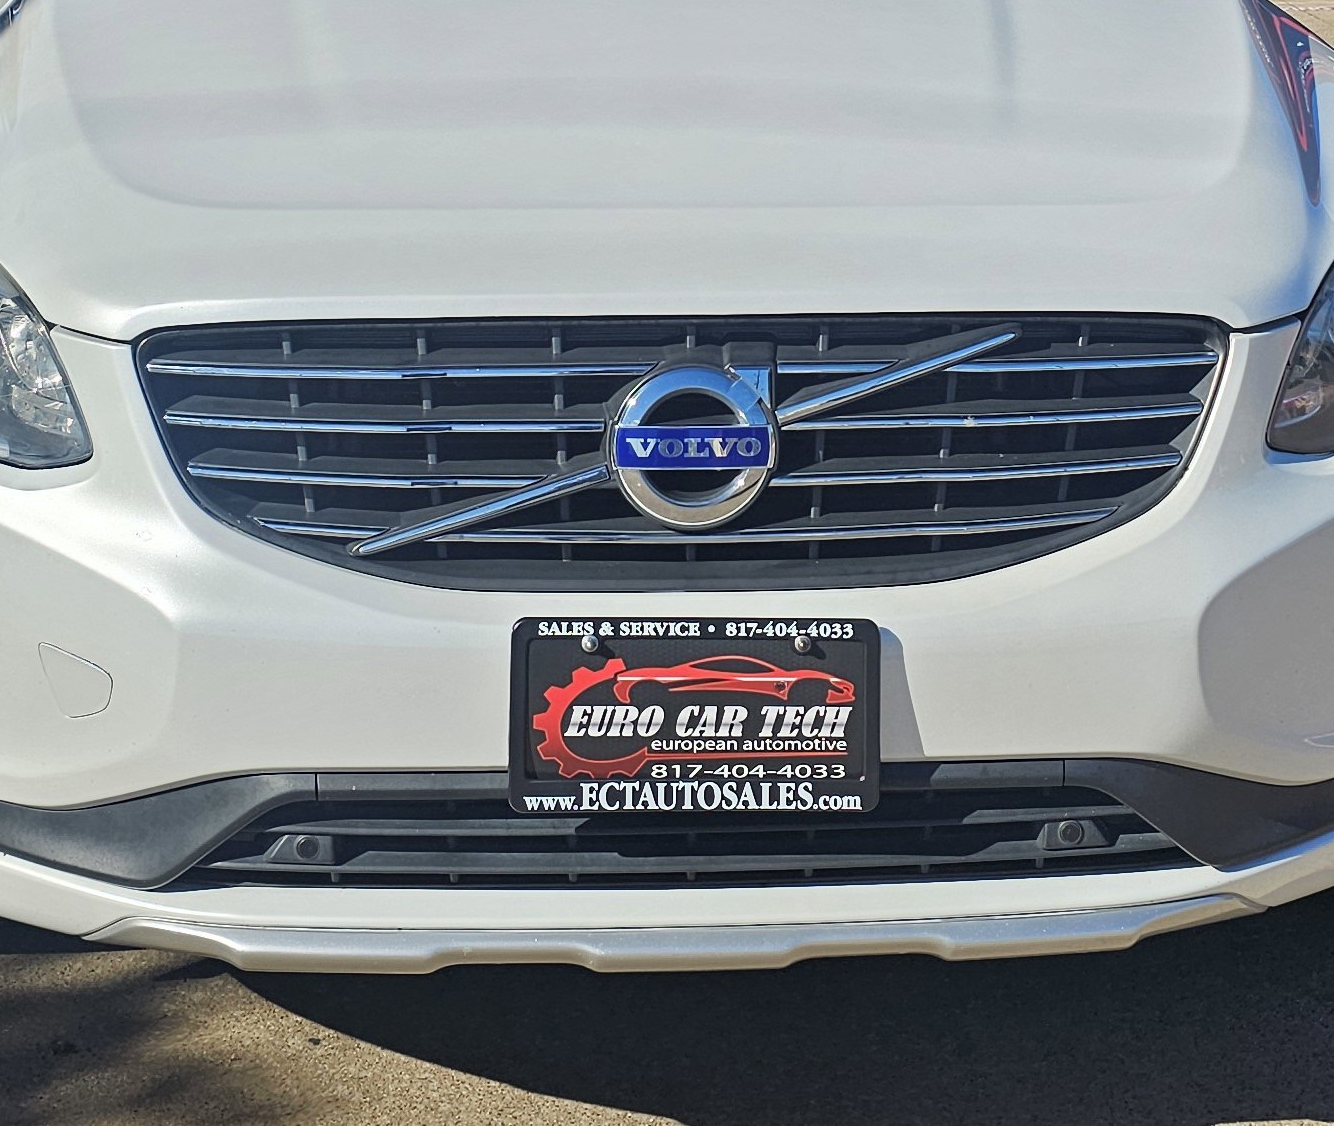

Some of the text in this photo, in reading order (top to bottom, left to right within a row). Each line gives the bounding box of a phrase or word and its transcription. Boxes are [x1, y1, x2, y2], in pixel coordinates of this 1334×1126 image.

[626, 437, 762, 458] VOLVO
[538, 621, 854, 639] SALES & SERVICE 817-404-4033
[563, 705, 853, 738] EURO CAR TECH
[650, 737, 848, 754] european automotive
[650, 763, 846, 779] 817-404-4033
[523, 780, 862, 812] www.ECTAUTOSALES.com
